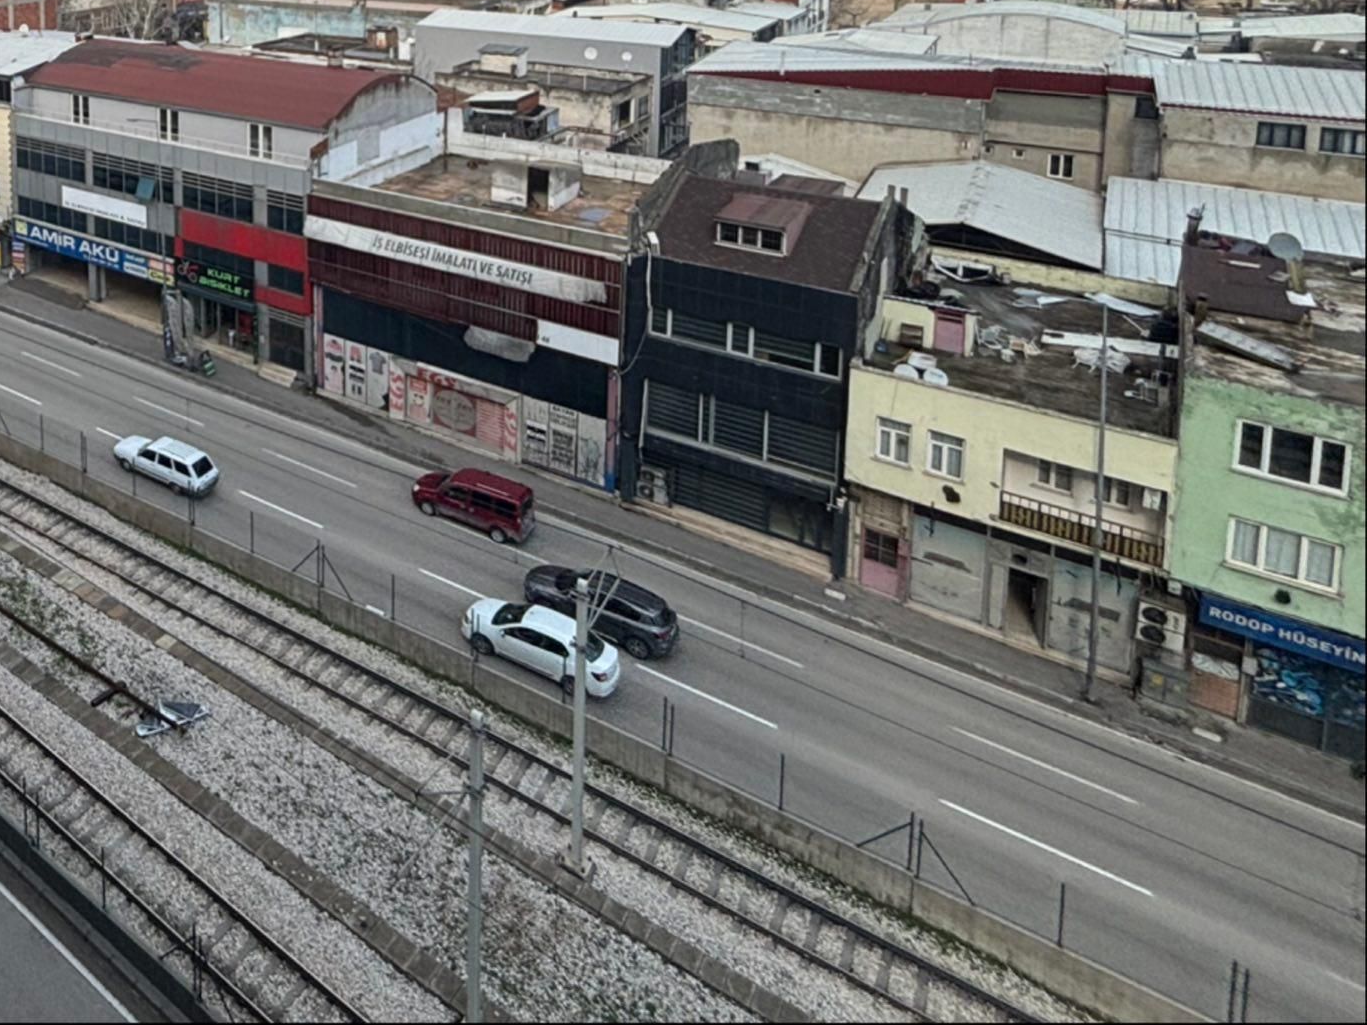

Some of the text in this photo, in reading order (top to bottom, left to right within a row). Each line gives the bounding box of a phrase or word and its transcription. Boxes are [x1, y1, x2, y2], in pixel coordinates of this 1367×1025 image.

[207, 268, 240, 284] KURT
[384, 238, 431, 260] ELBİSESİ
[479, 261, 495, 275] VE
[495, 265, 533, 285] SATIŞI
[1209, 606, 1274, 633] RODOP
[1278, 628, 1366, 665] HÜSEYİN
